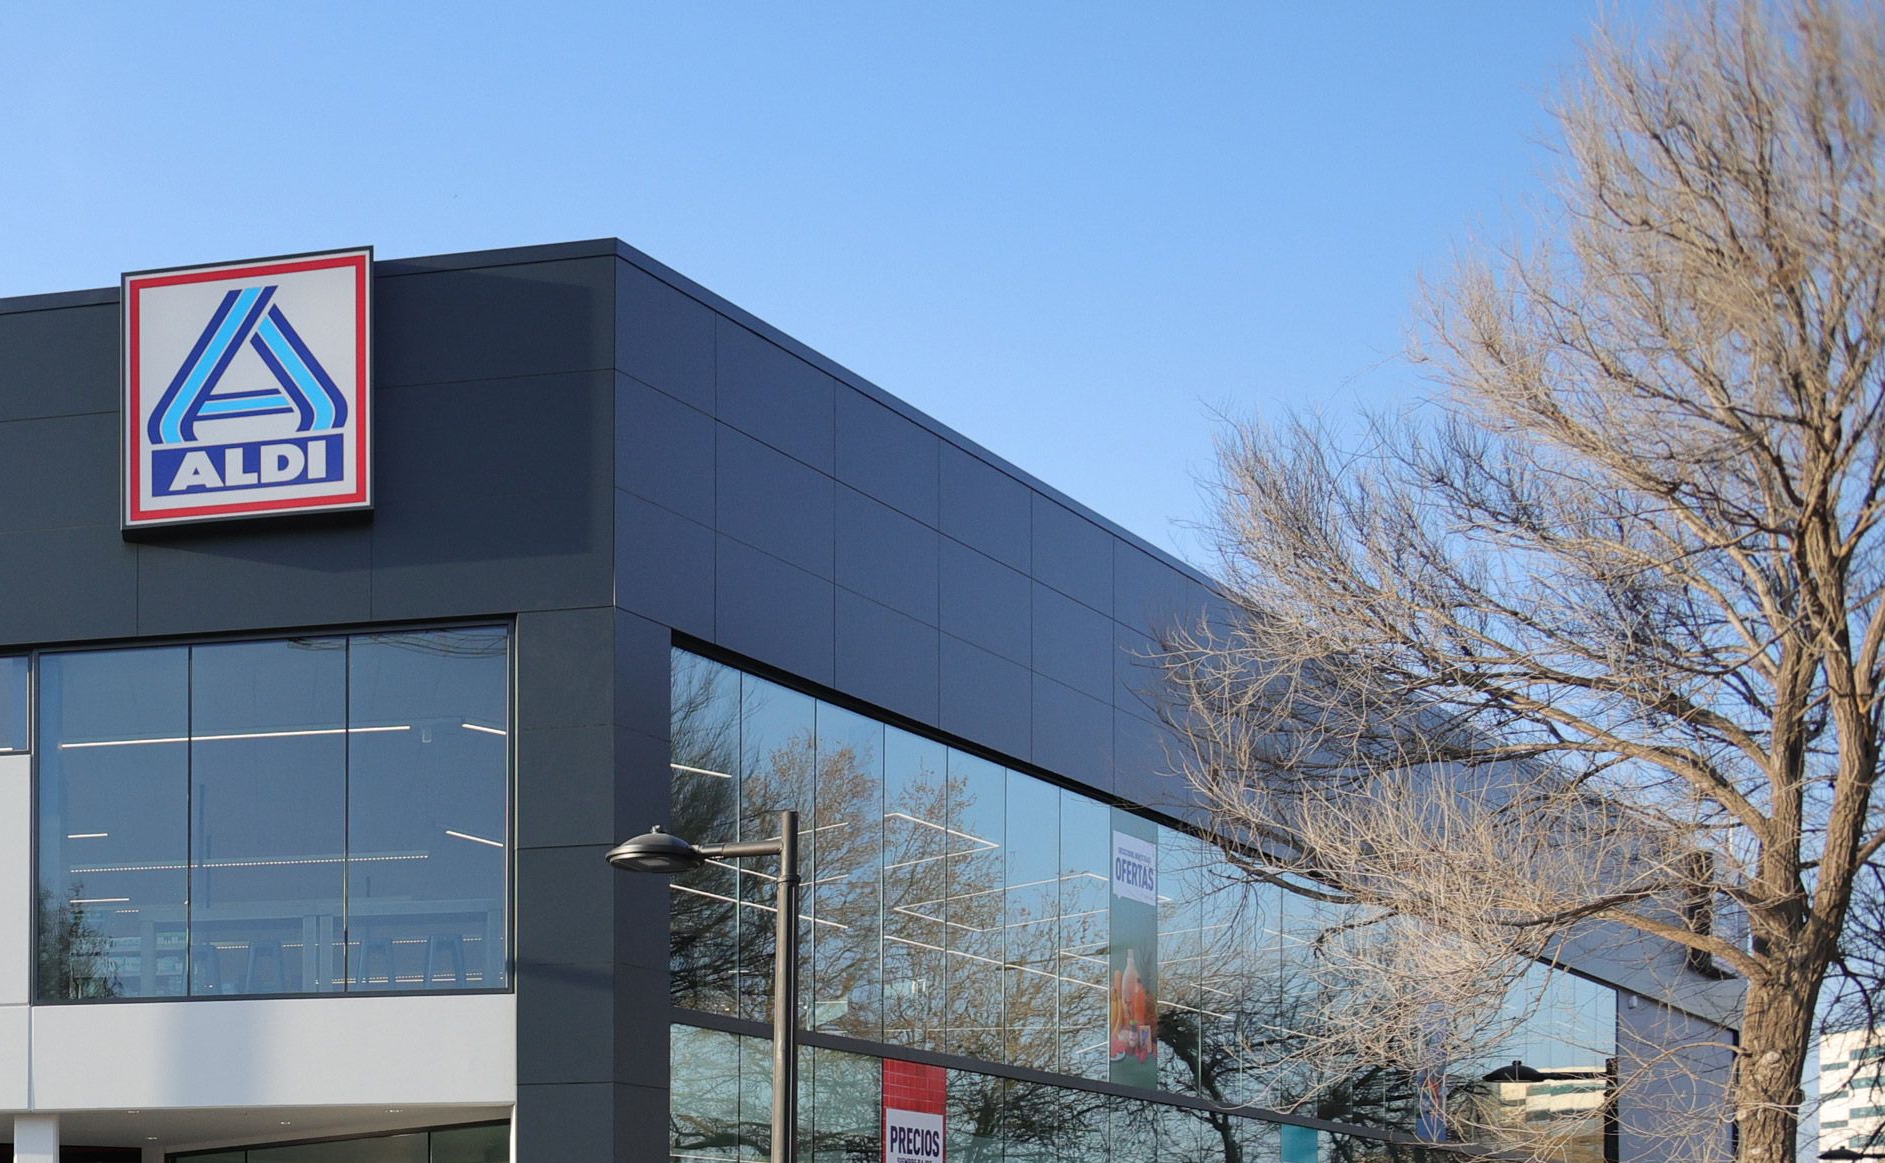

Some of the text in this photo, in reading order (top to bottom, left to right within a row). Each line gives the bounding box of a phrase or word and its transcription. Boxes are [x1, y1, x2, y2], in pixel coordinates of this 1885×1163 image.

[168, 439, 327, 492] ALDI
[1115, 856, 1154, 892] OFERTAS
[890, 1125, 940, 1158] PRECIOS
